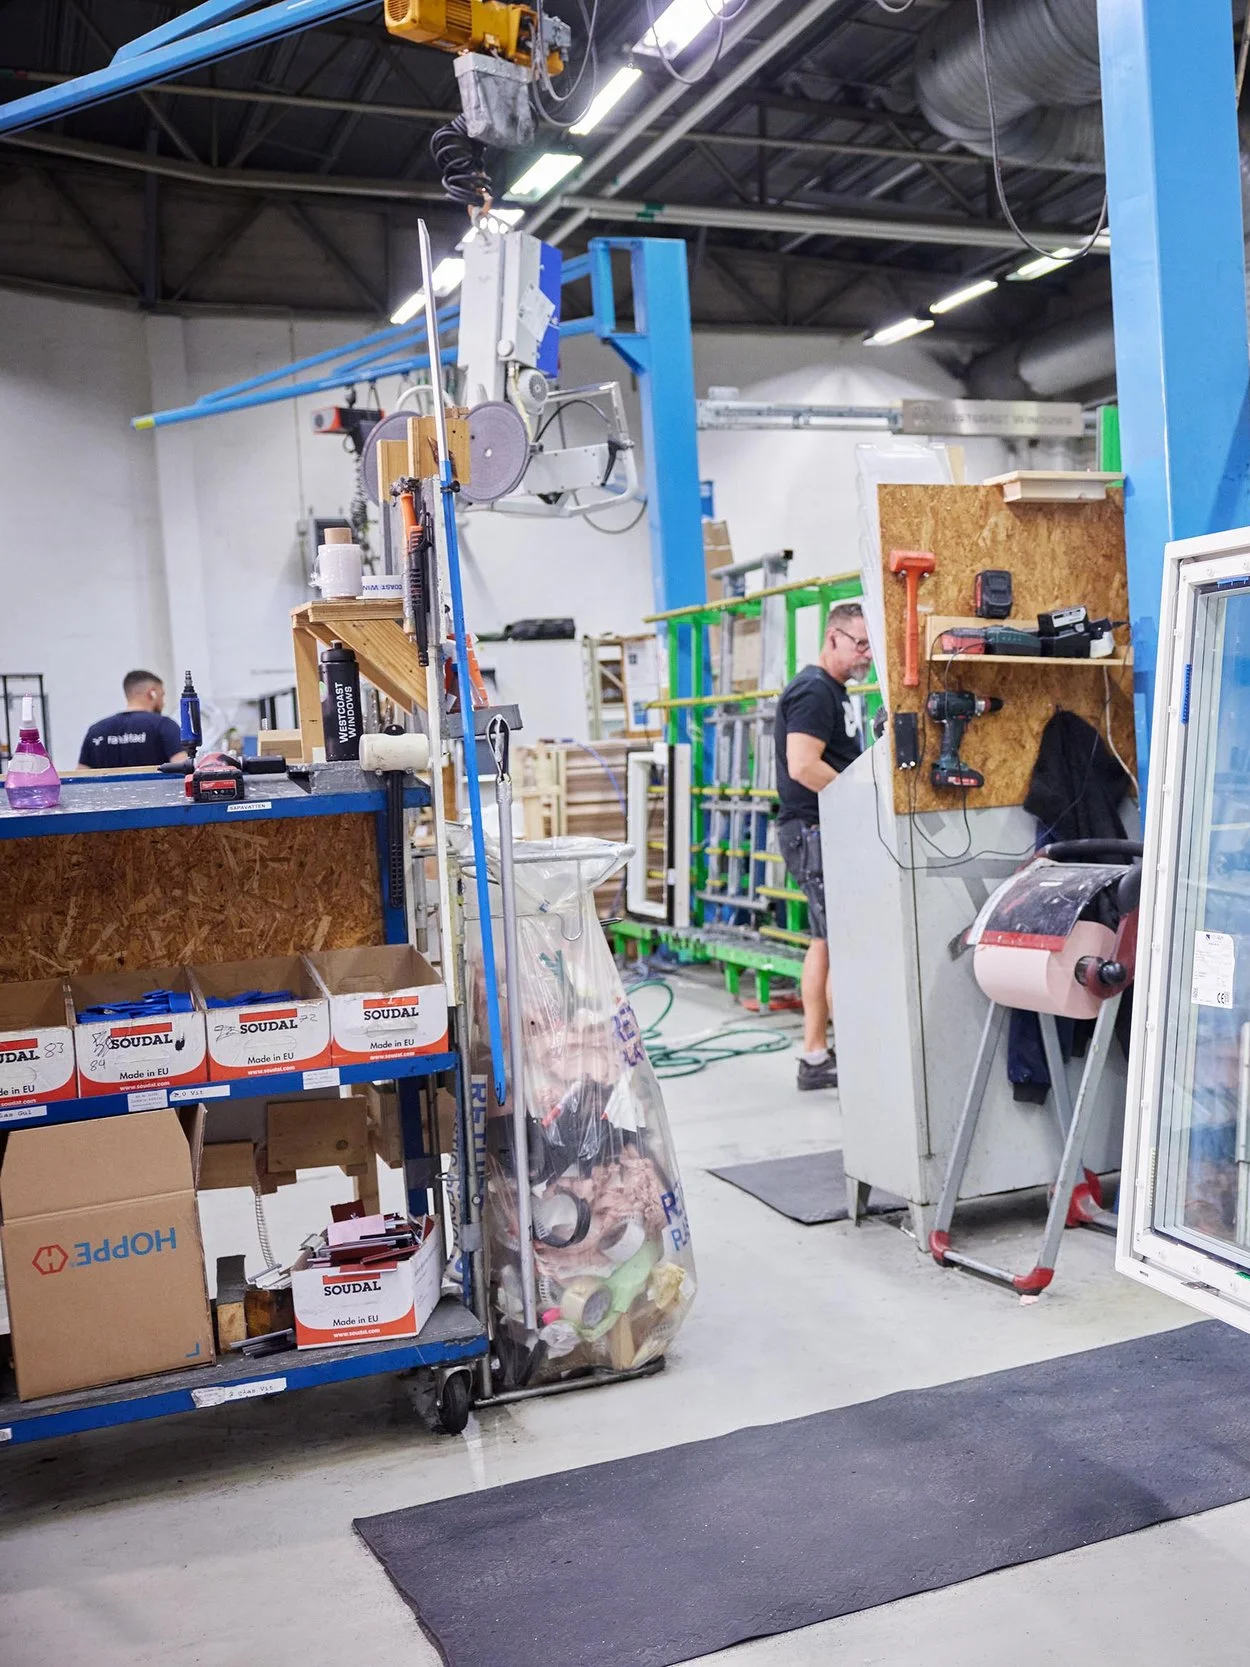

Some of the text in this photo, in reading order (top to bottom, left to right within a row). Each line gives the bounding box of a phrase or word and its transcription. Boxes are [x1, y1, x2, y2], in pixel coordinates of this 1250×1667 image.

[335, 682, 349, 744] WESTCOAST
[345, 685, 358, 743] WINDOWS
[364, 1007, 419, 1021] SOUDAL
[240, 1018, 298, 1035] SOUDAL
[111, 1034, 173, 1050] SOUDAL
[370, 1038, 415, 1050] Made in EU
[44, 1042, 64, 1059] 83
[247, 1052, 294, 1065] Made in EU
[120, 1067, 169, 1080] Made in EU
[11, 1087, 20, 1095] in
[23, 1084, 35, 1094] EU
[120, 1081, 170, 1091] www.soudal.com
[74, 1227, 177, 1266] HOPPE
[324, 1281, 381, 1296] SOUDAL
[332, 1315, 379, 1327] Made in EU
[333, 1328, 381, 1338] www.soudal.com
